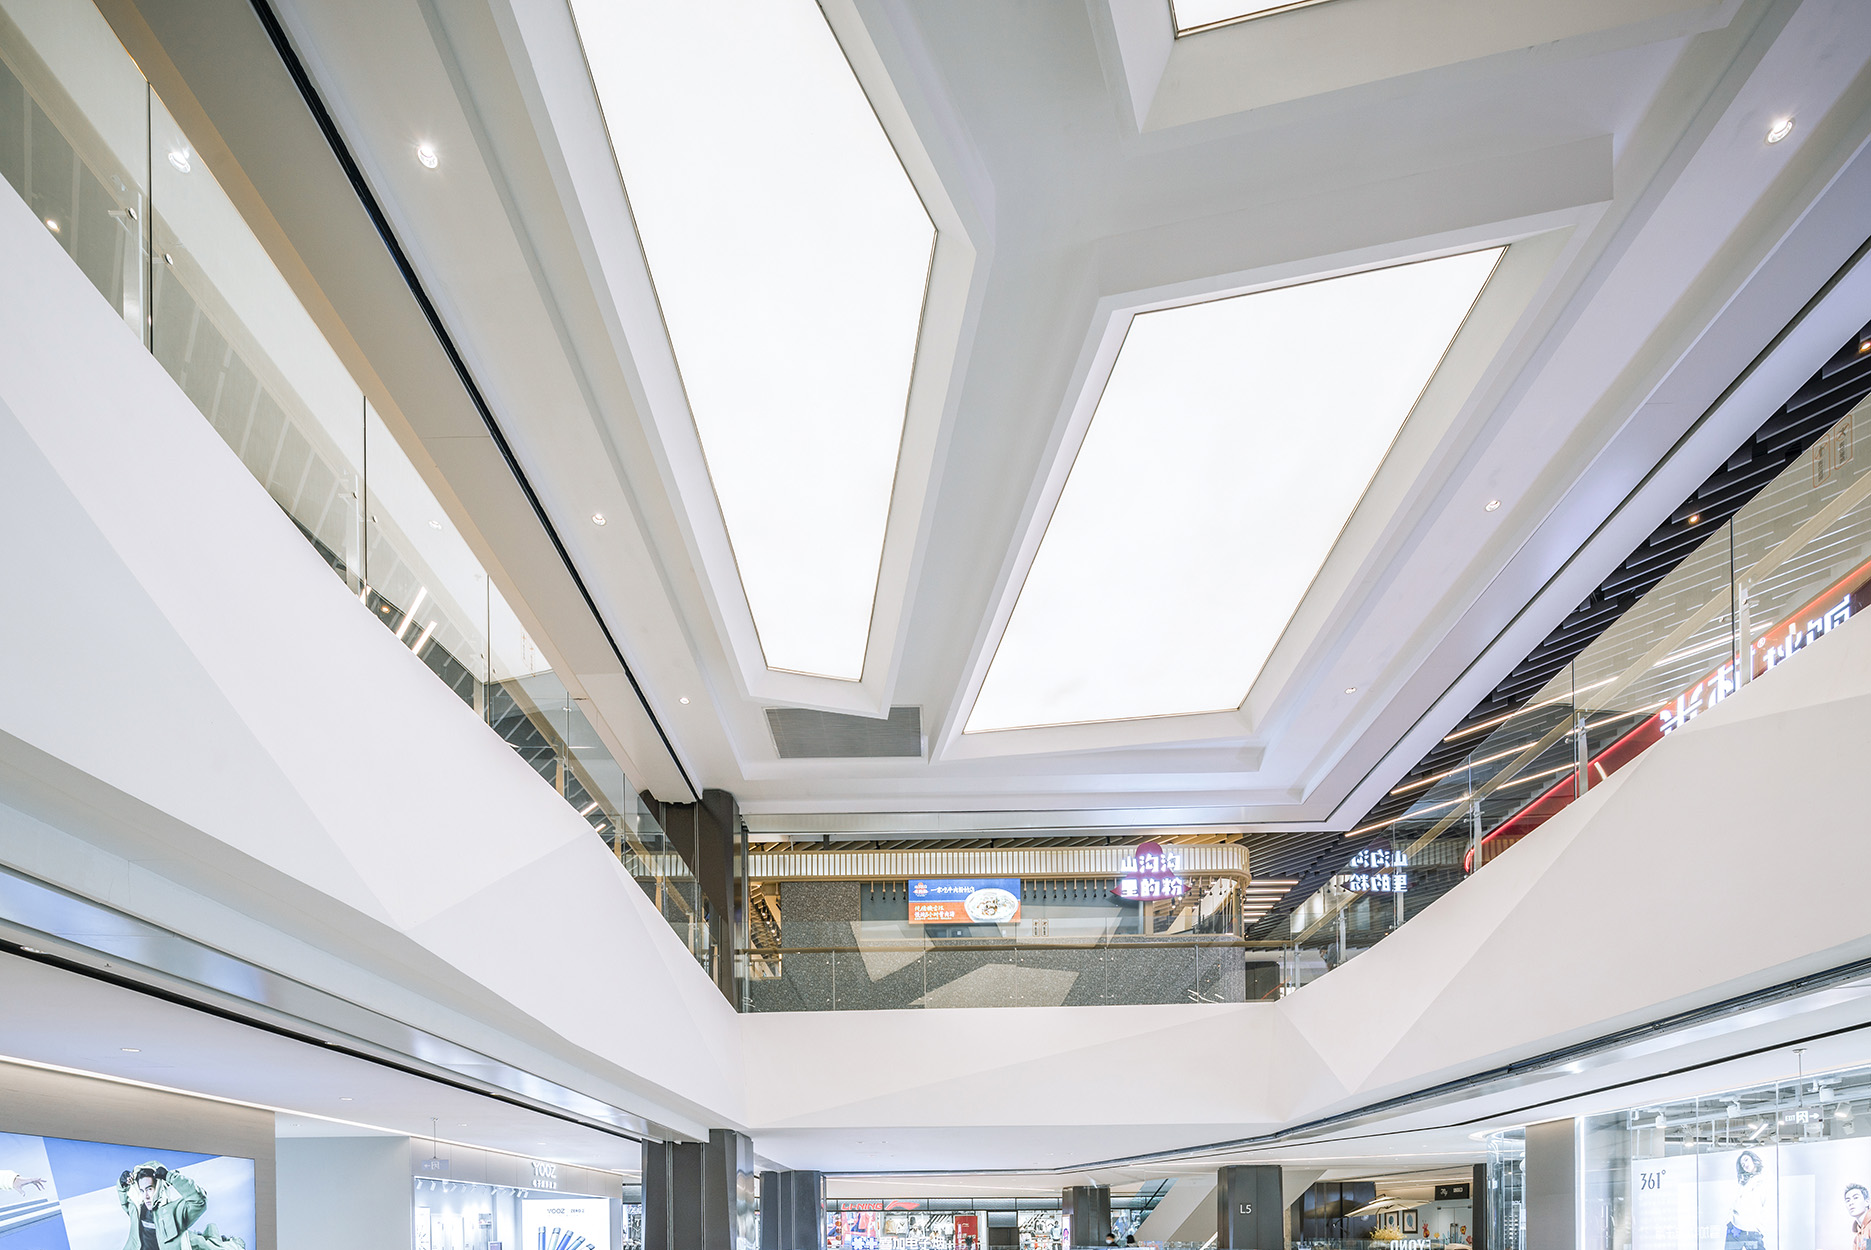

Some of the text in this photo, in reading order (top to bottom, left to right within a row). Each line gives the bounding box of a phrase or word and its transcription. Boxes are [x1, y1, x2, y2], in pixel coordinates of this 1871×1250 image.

[1120, 852, 1181, 873] 山沟沟
[1121, 877, 1183, 897] 里的粉
[532, 1161, 557, 1178] YOOZ
[1239, 1204, 1252, 1214] L5
